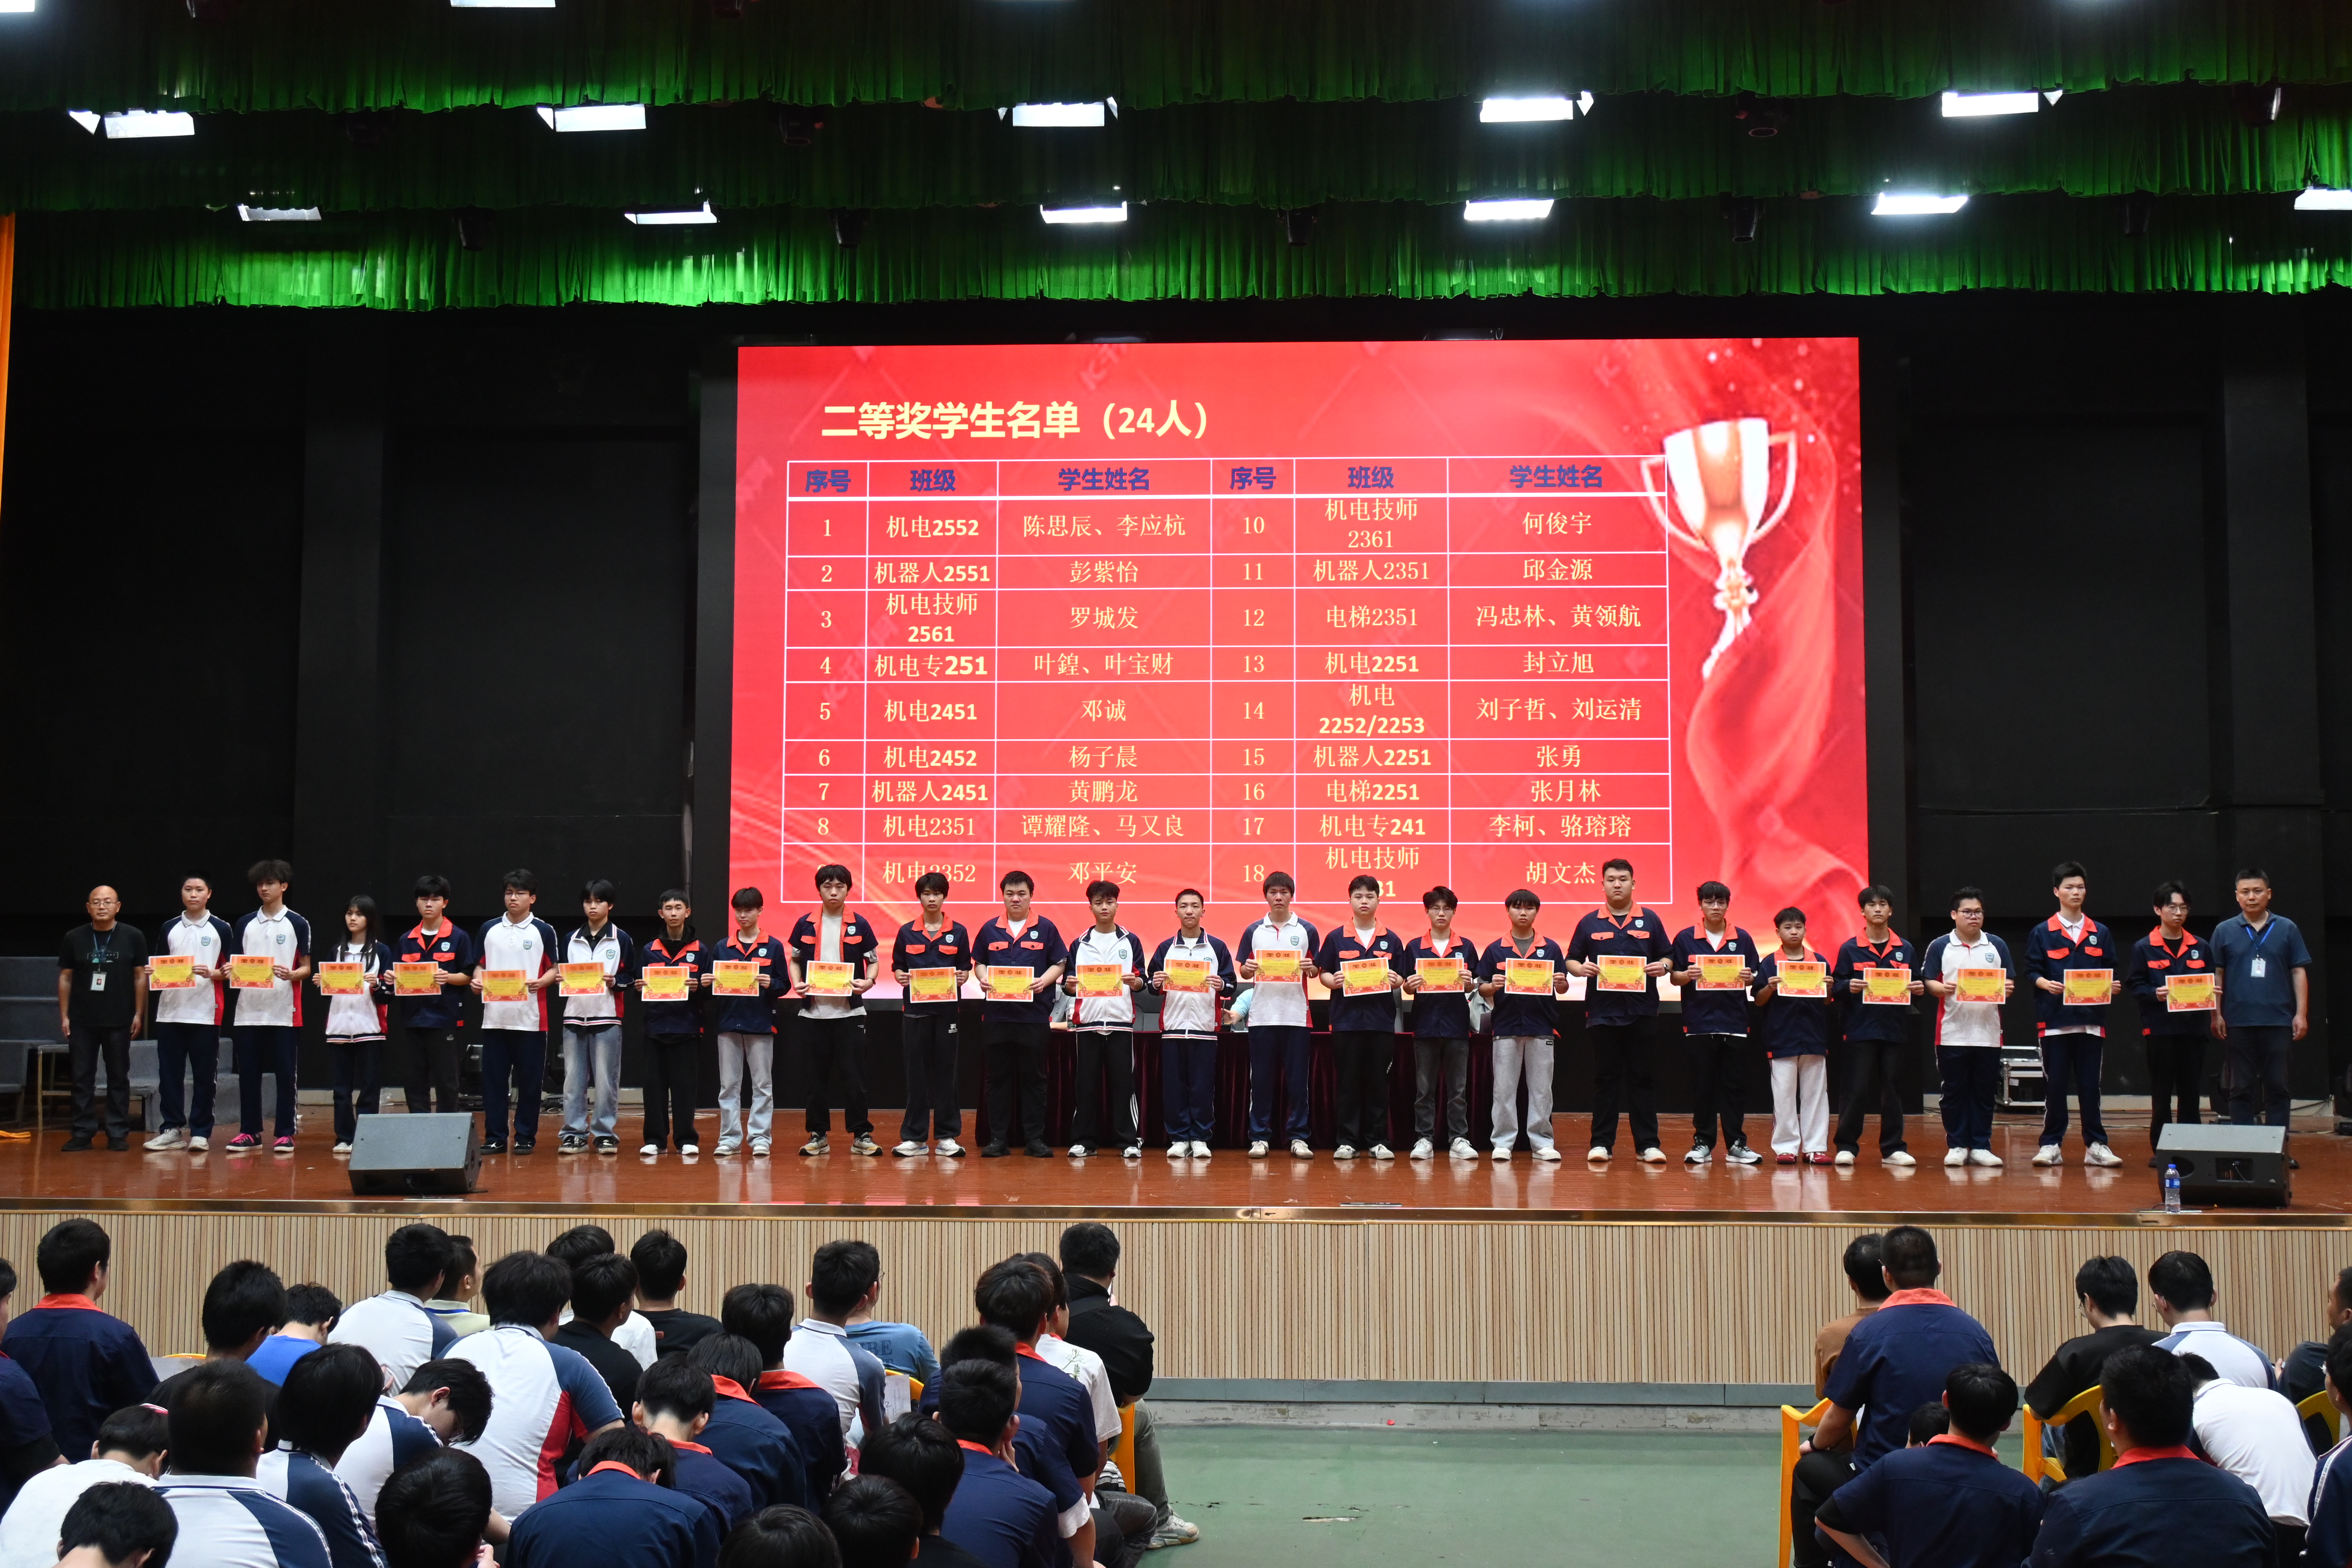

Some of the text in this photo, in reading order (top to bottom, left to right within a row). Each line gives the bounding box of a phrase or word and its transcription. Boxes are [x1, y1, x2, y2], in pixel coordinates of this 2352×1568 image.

[806, 469, 851, 493] 序号
[910, 469, 956, 492] 班级
[1058, 467, 1149, 491] 学生姓名
[1230, 467, 1276, 490] 序号
[1348, 466, 1394, 489] 班级
[1510, 464, 1602, 488] 学生姓名
[1325, 498, 1417, 521] 机电技师
[824, 519, 831, 536] 1
[886, 515, 979, 538] 机电2552
[1024, 514, 1186, 537] 陈思辰、李应杭
[1244, 517, 1265, 534] 10
[1522, 512, 1592, 535] 何俊宇
[1348, 530, 1393, 548] 2361
[821, 565, 832, 582] 2
[874, 561, 990, 584] 机器人2551
[1070, 560, 1138, 583] 彭紫怡
[1244, 563, 1263, 580] 11
[1313, 559, 1429, 582] 机器人2351
[1523, 558, 1592, 581] 邱金源
[885, 592, 978, 615] 机电技师
[821, 610, 832, 628] 3
[1070, 606, 1138, 629] 罗城发
[1244, 609, 1264, 626] 12
[1327, 605, 1418, 628] 电梯2351
[1476, 604, 1641, 627] 冯忠林、黄领航
[908, 626, 955, 642] 2561
[820, 656, 831, 674] 4
[874, 654, 988, 677] 机电专251
[1244, 655, 1264, 672] 13
[1325, 651, 1419, 674] 机电2251
[1523, 651, 1594, 674] 封立旭
[1349, 683, 1395, 706] 机电
[819, 702, 830, 720] 5
[884, 699, 977, 722] 机电2451
[1081, 699, 1126, 722] 邓诚
[1244, 702, 1264, 719] 14
[1476, 697, 1642, 721] 刘子哲、刘运清
[1319, 715, 1425, 737] 2252/2253
[819, 749, 830, 766] 6
[883, 746, 977, 768] 机电2452
[1069, 745, 1138, 768] 杨子晨
[1244, 748, 1264, 766] 15
[1313, 745, 1431, 768] 机器人2251
[1537, 745, 1581, 768] 张勇
[819, 783, 829, 800] 7
[871, 780, 988, 803] 机器人2451
[1068, 780, 1138, 803] 黄鹏龙
[1244, 783, 1265, 800] 16
[1327, 779, 1420, 802] 电梯2251
[1531, 779, 1601, 802] 张月林
[818, 818, 829, 835] 8
[883, 814, 975, 837] 机电2351
[1021, 814, 1184, 838] 谭耀隆、马又良
[1244, 817, 1264, 835] 17
[1319, 814, 1426, 837] 机电专241
[1489, 814, 1631, 837] 李柯、骆瑢瑢
[1326, 846, 1419, 869] 机电技师
[1068, 861, 1137, 884] 邓平安
[1244, 864, 1264, 882] 18
[1526, 861, 1596, 884] 胡文杰
